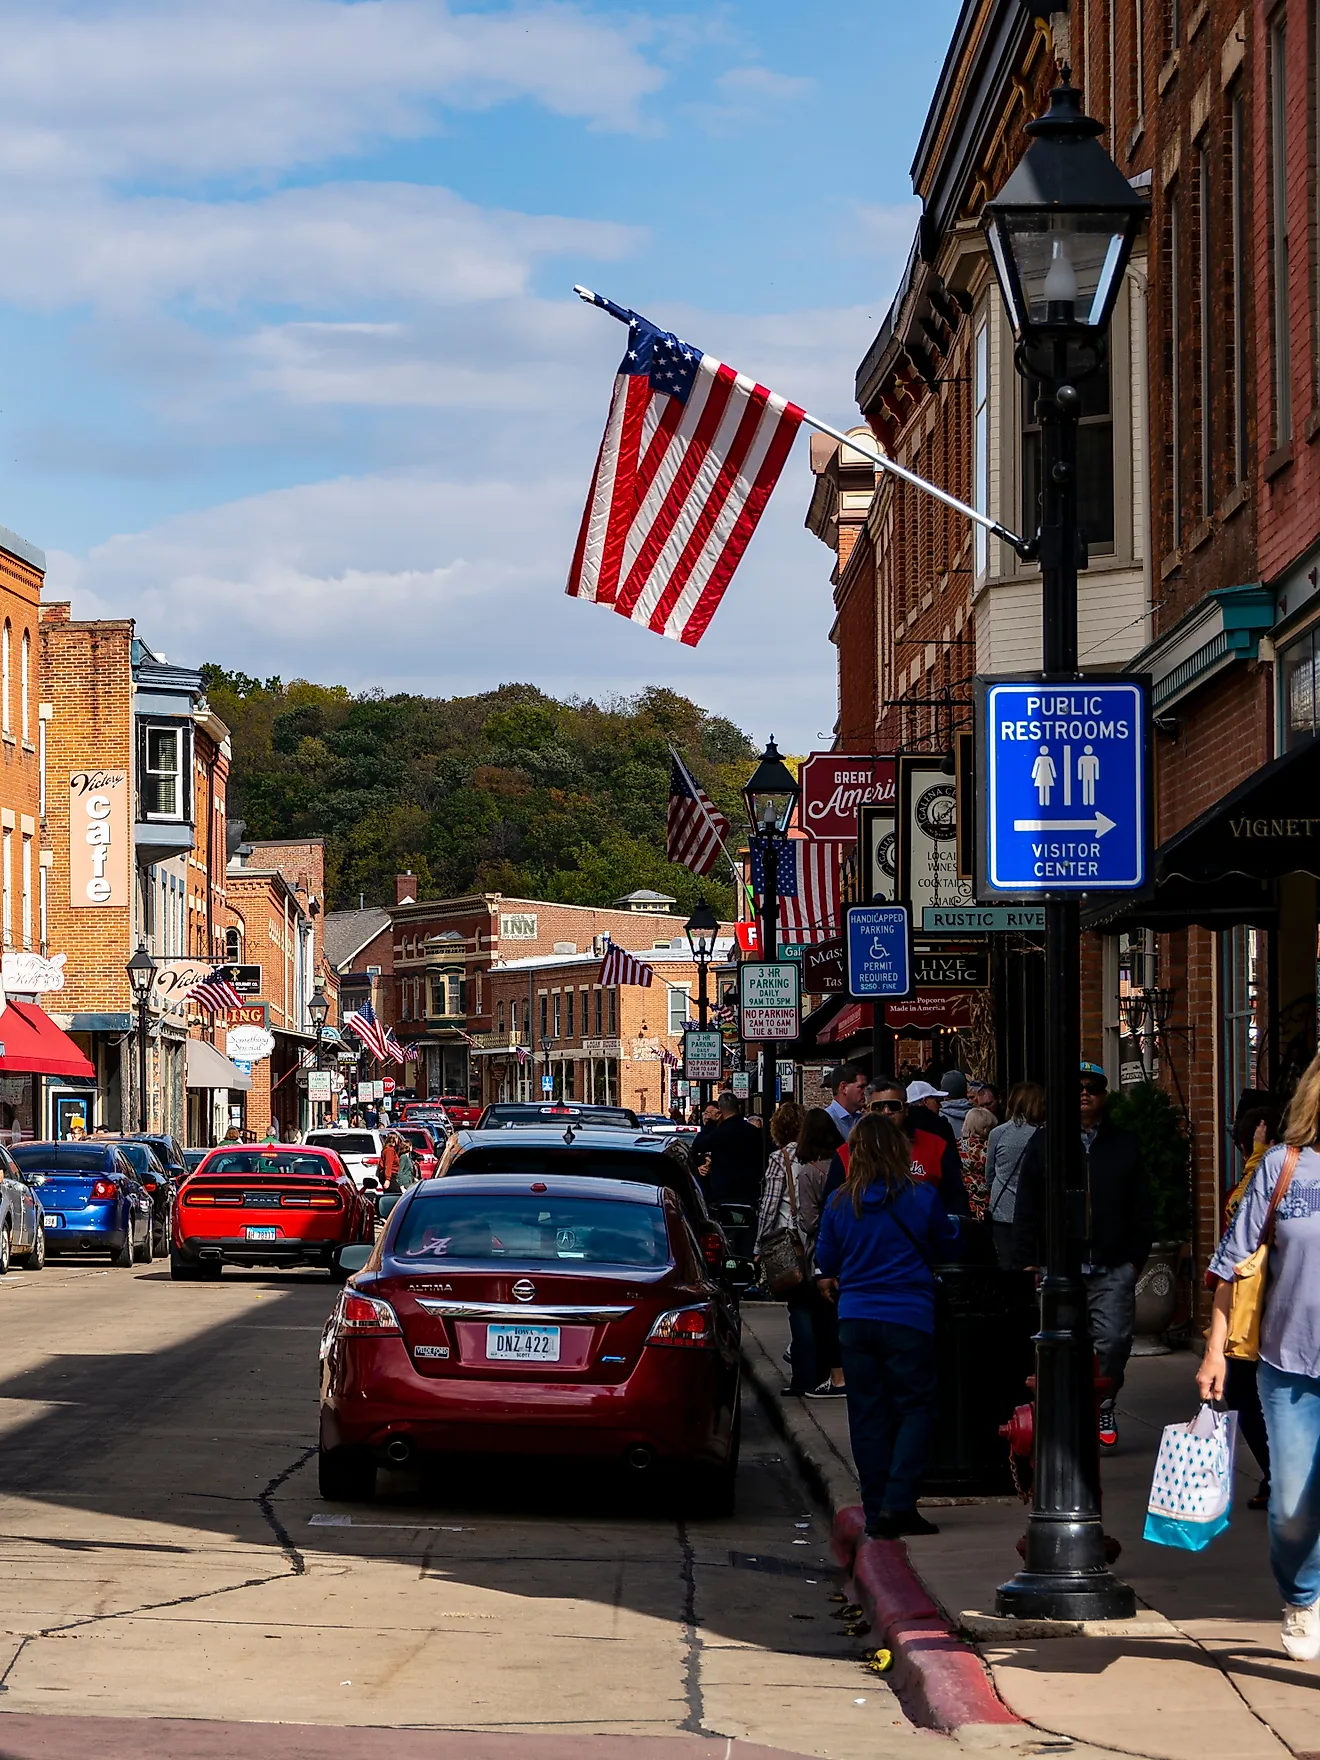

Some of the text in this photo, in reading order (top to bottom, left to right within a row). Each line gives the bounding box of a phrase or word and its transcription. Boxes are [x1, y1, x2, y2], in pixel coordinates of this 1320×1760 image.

[1027, 697, 1102, 715] PUBLIC
[1001, 721, 1129, 741] RESTROOMS
[834, 771, 872, 784] GREAT
[71, 771, 123, 797] Victory
[1229, 819, 1320, 837] VIGNET
[86, 795, 111, 902] cafe
[1032, 844, 1100, 858] VISITOR
[1034, 862, 1098, 876] CENTER
[851, 913, 903, 923] HANDICAPPED
[934, 913, 994, 926] RUSTIC
[502, 920, 535, 934] INN
[860, 925, 895, 934] PARKING
[864, 962, 892, 970] PERMIT
[921, 960, 966, 969] LIVE
[759, 968, 780, 977] 3 HR
[860, 973, 898, 982] REQUIRED
[914, 970, 977, 980] MUSIC
[158, 969, 203, 994] Victo
[750, 979, 789, 988] PARKING
[823, 978, 843, 987] Tas
[917, 997, 946, 1005] Popcorn
[227, 1010, 262, 1022] ING
[746, 1009, 794, 1018] NO PARKING
[407, 1284, 453, 1292] ALTIMA
[497, 1336, 549, 1353] DNZ 422
